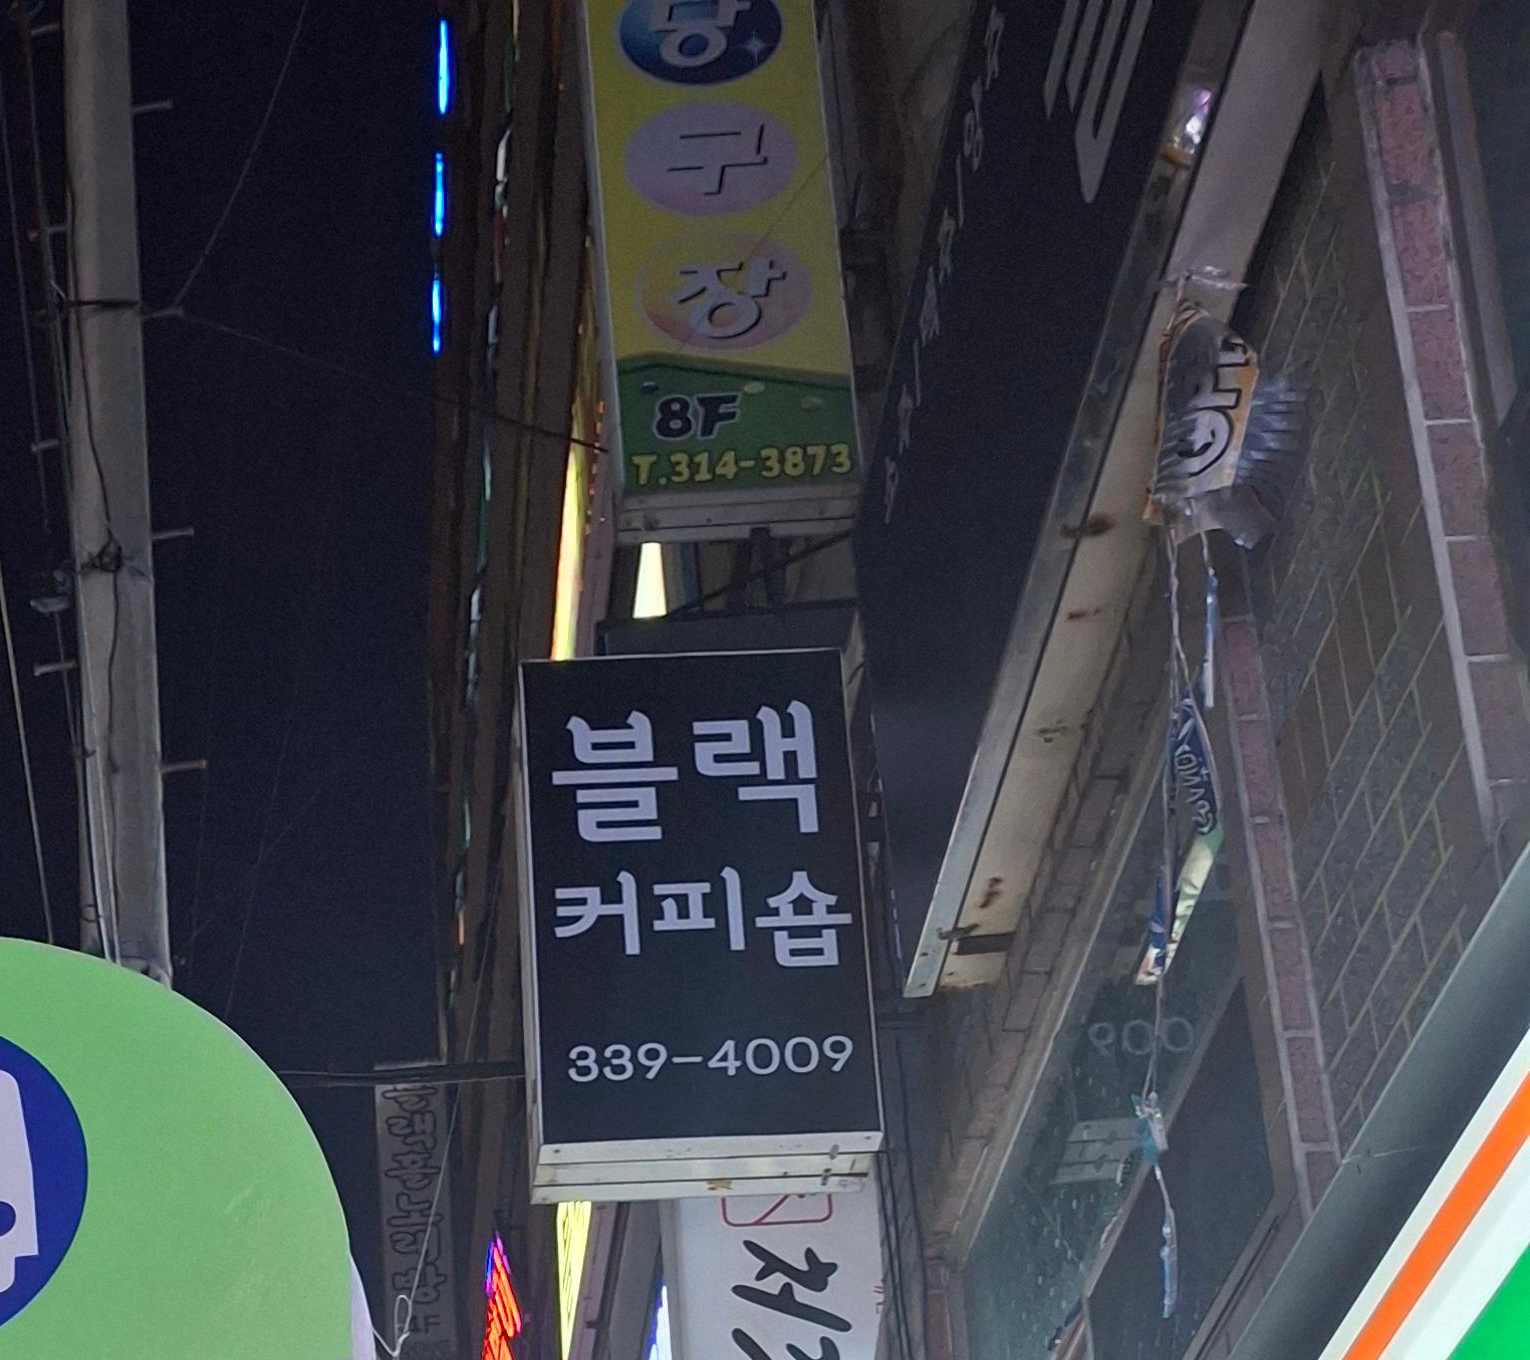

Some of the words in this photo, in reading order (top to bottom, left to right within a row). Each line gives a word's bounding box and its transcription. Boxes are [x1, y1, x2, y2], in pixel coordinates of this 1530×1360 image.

[653, 393, 741, 440] 8F
[632, 443, 851, 486] T.314-3873
[552, 700, 819, 842] 블랙
[554, 866, 853, 967] 커피숍
[568, 1035, 853, 1083] 339-4009
